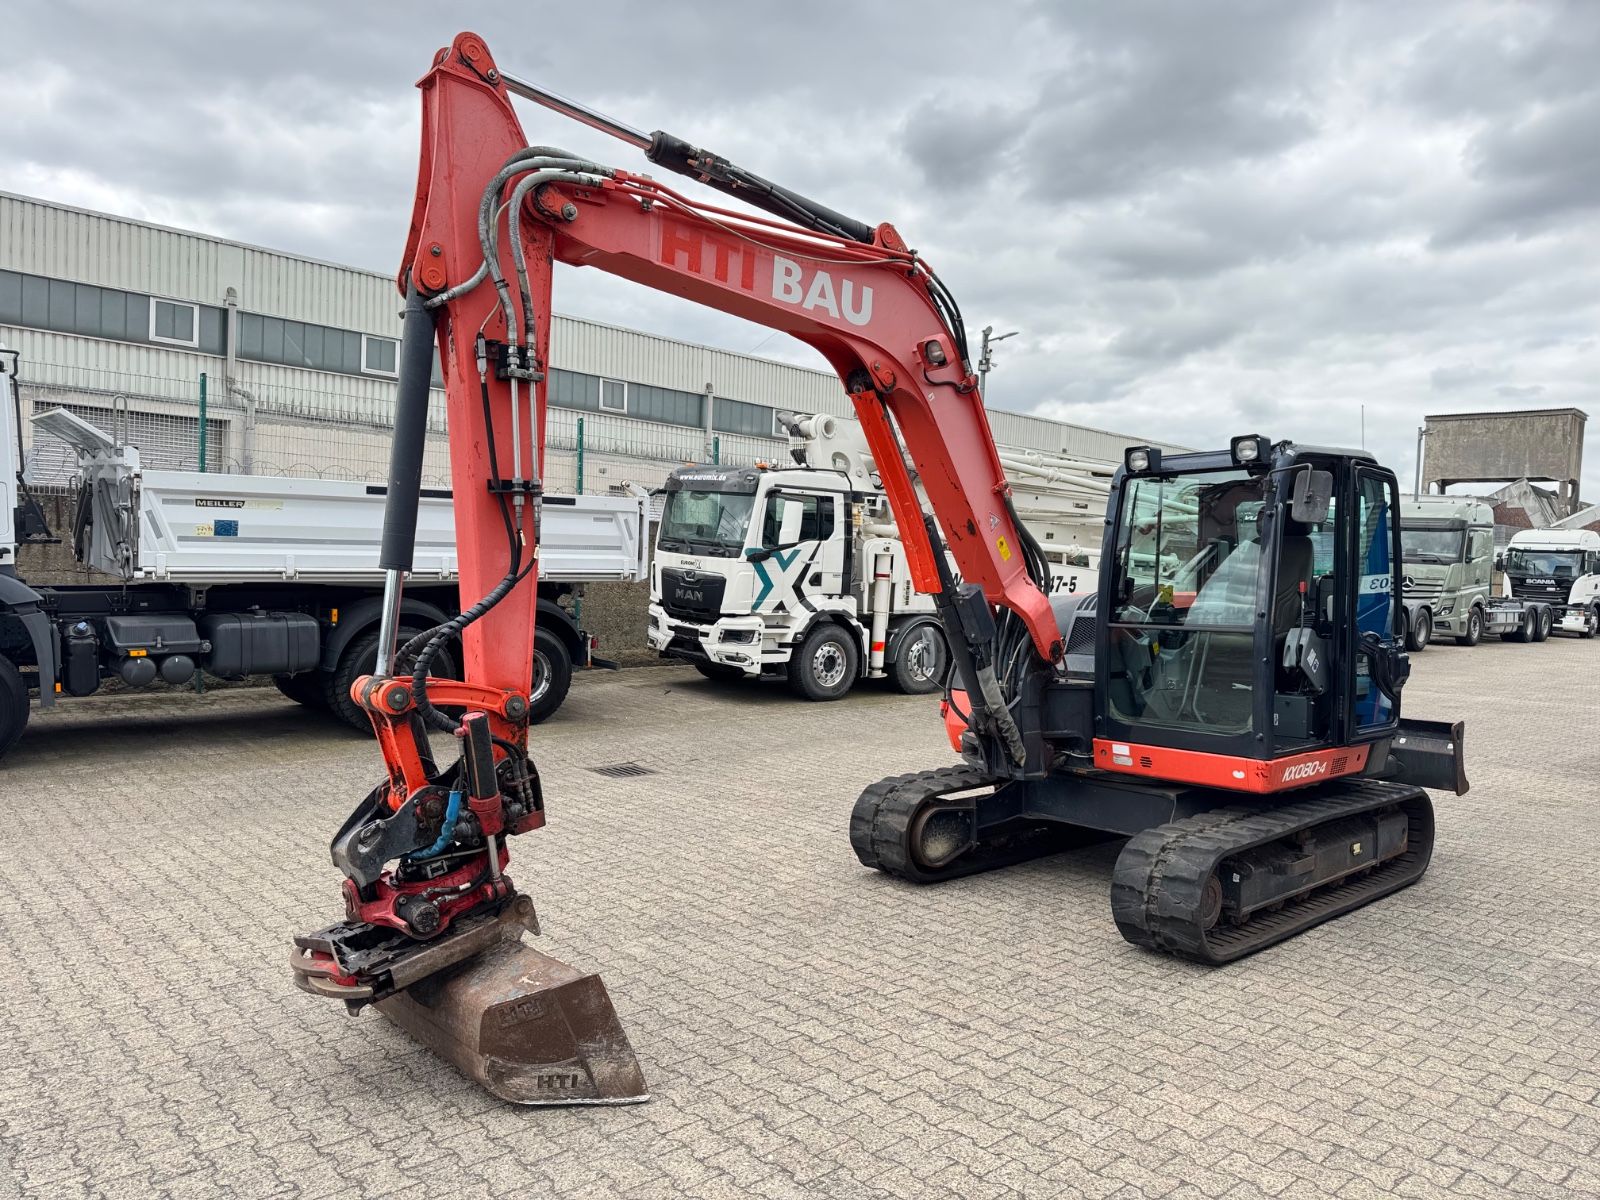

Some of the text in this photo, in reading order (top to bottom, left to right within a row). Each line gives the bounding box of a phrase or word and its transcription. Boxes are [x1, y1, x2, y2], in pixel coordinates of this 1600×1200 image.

[661, 224, 874, 327] HTI BAU
[196, 500, 244, 508] MEILLER
[675, 588, 704, 602] MAN
[1281, 760, 1328, 783] KX080-4
[537, 1073, 579, 1089] HTI
